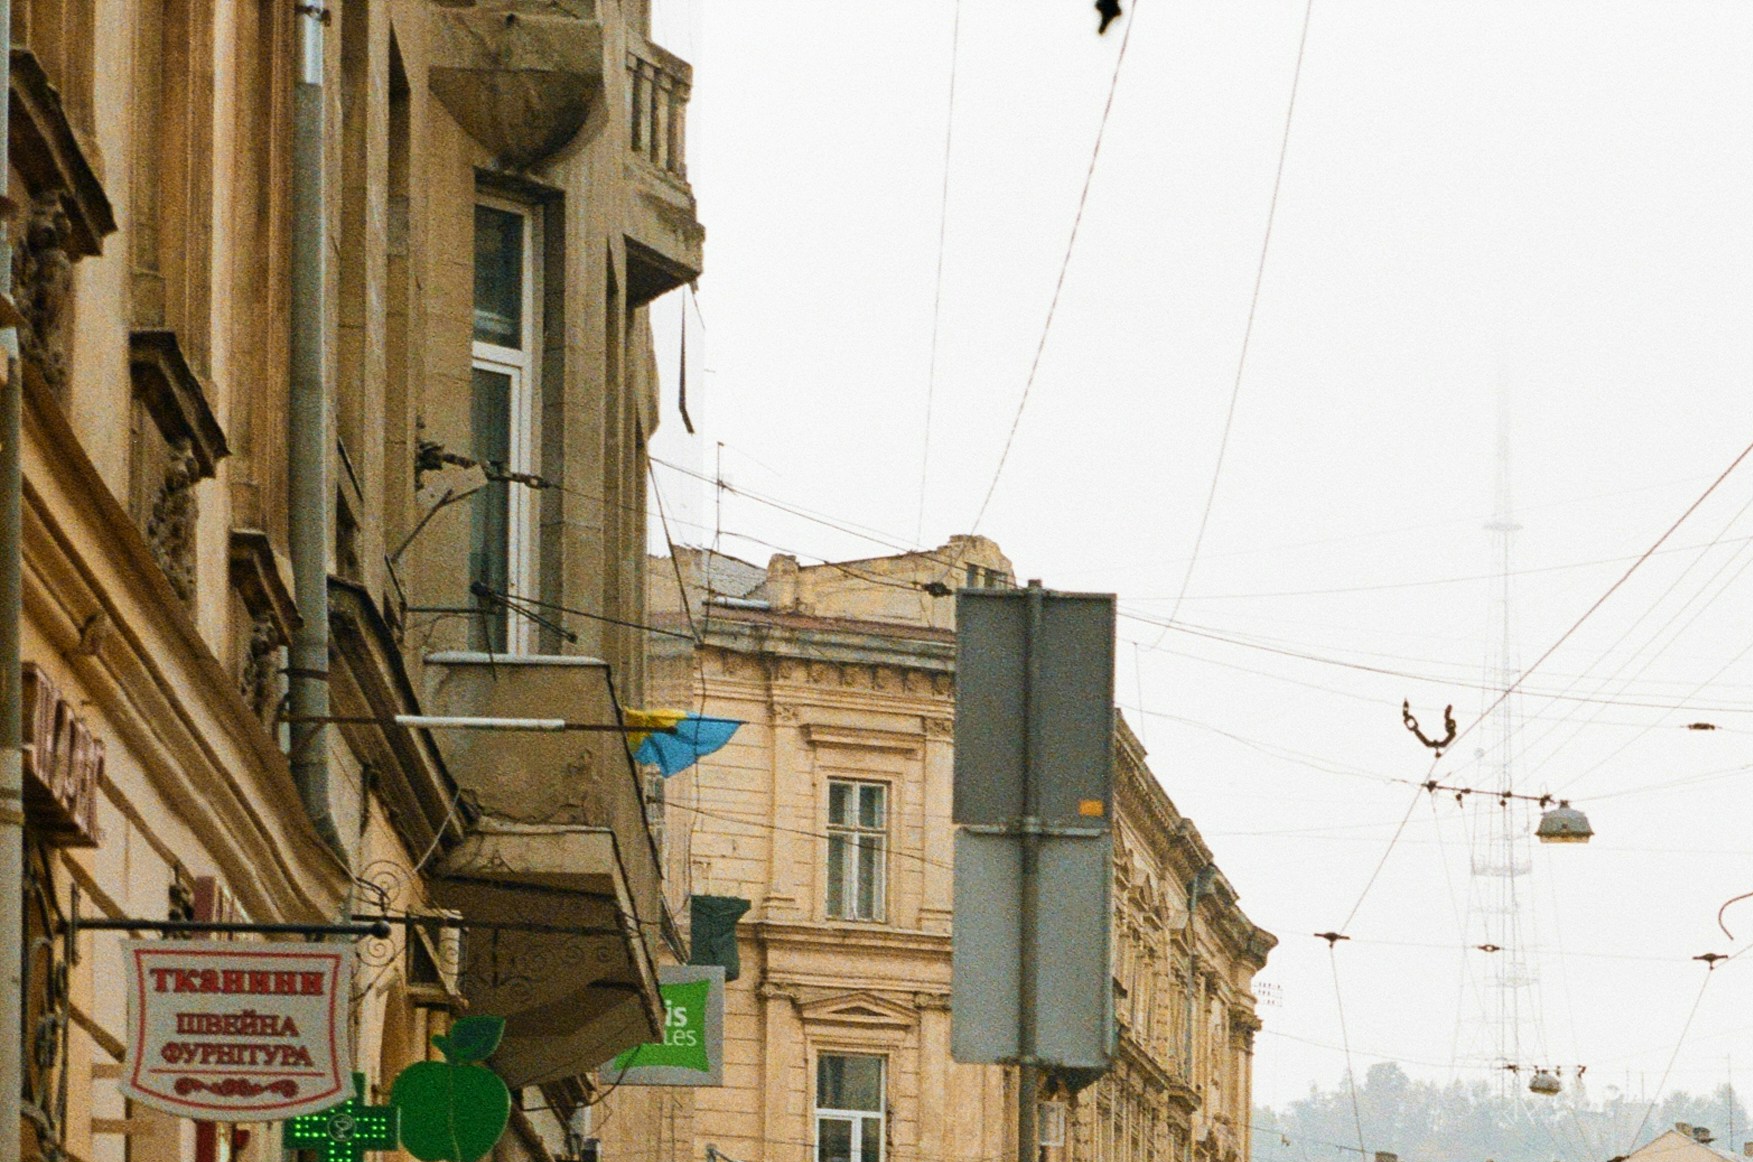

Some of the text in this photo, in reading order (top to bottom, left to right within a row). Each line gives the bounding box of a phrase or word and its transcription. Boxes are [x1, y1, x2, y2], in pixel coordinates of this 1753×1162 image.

[176, 1009, 299, 1037] ШВЕЙНА
[664, 999, 688, 1027] is
[160, 1041, 314, 1067] ФУРНІТУРА
